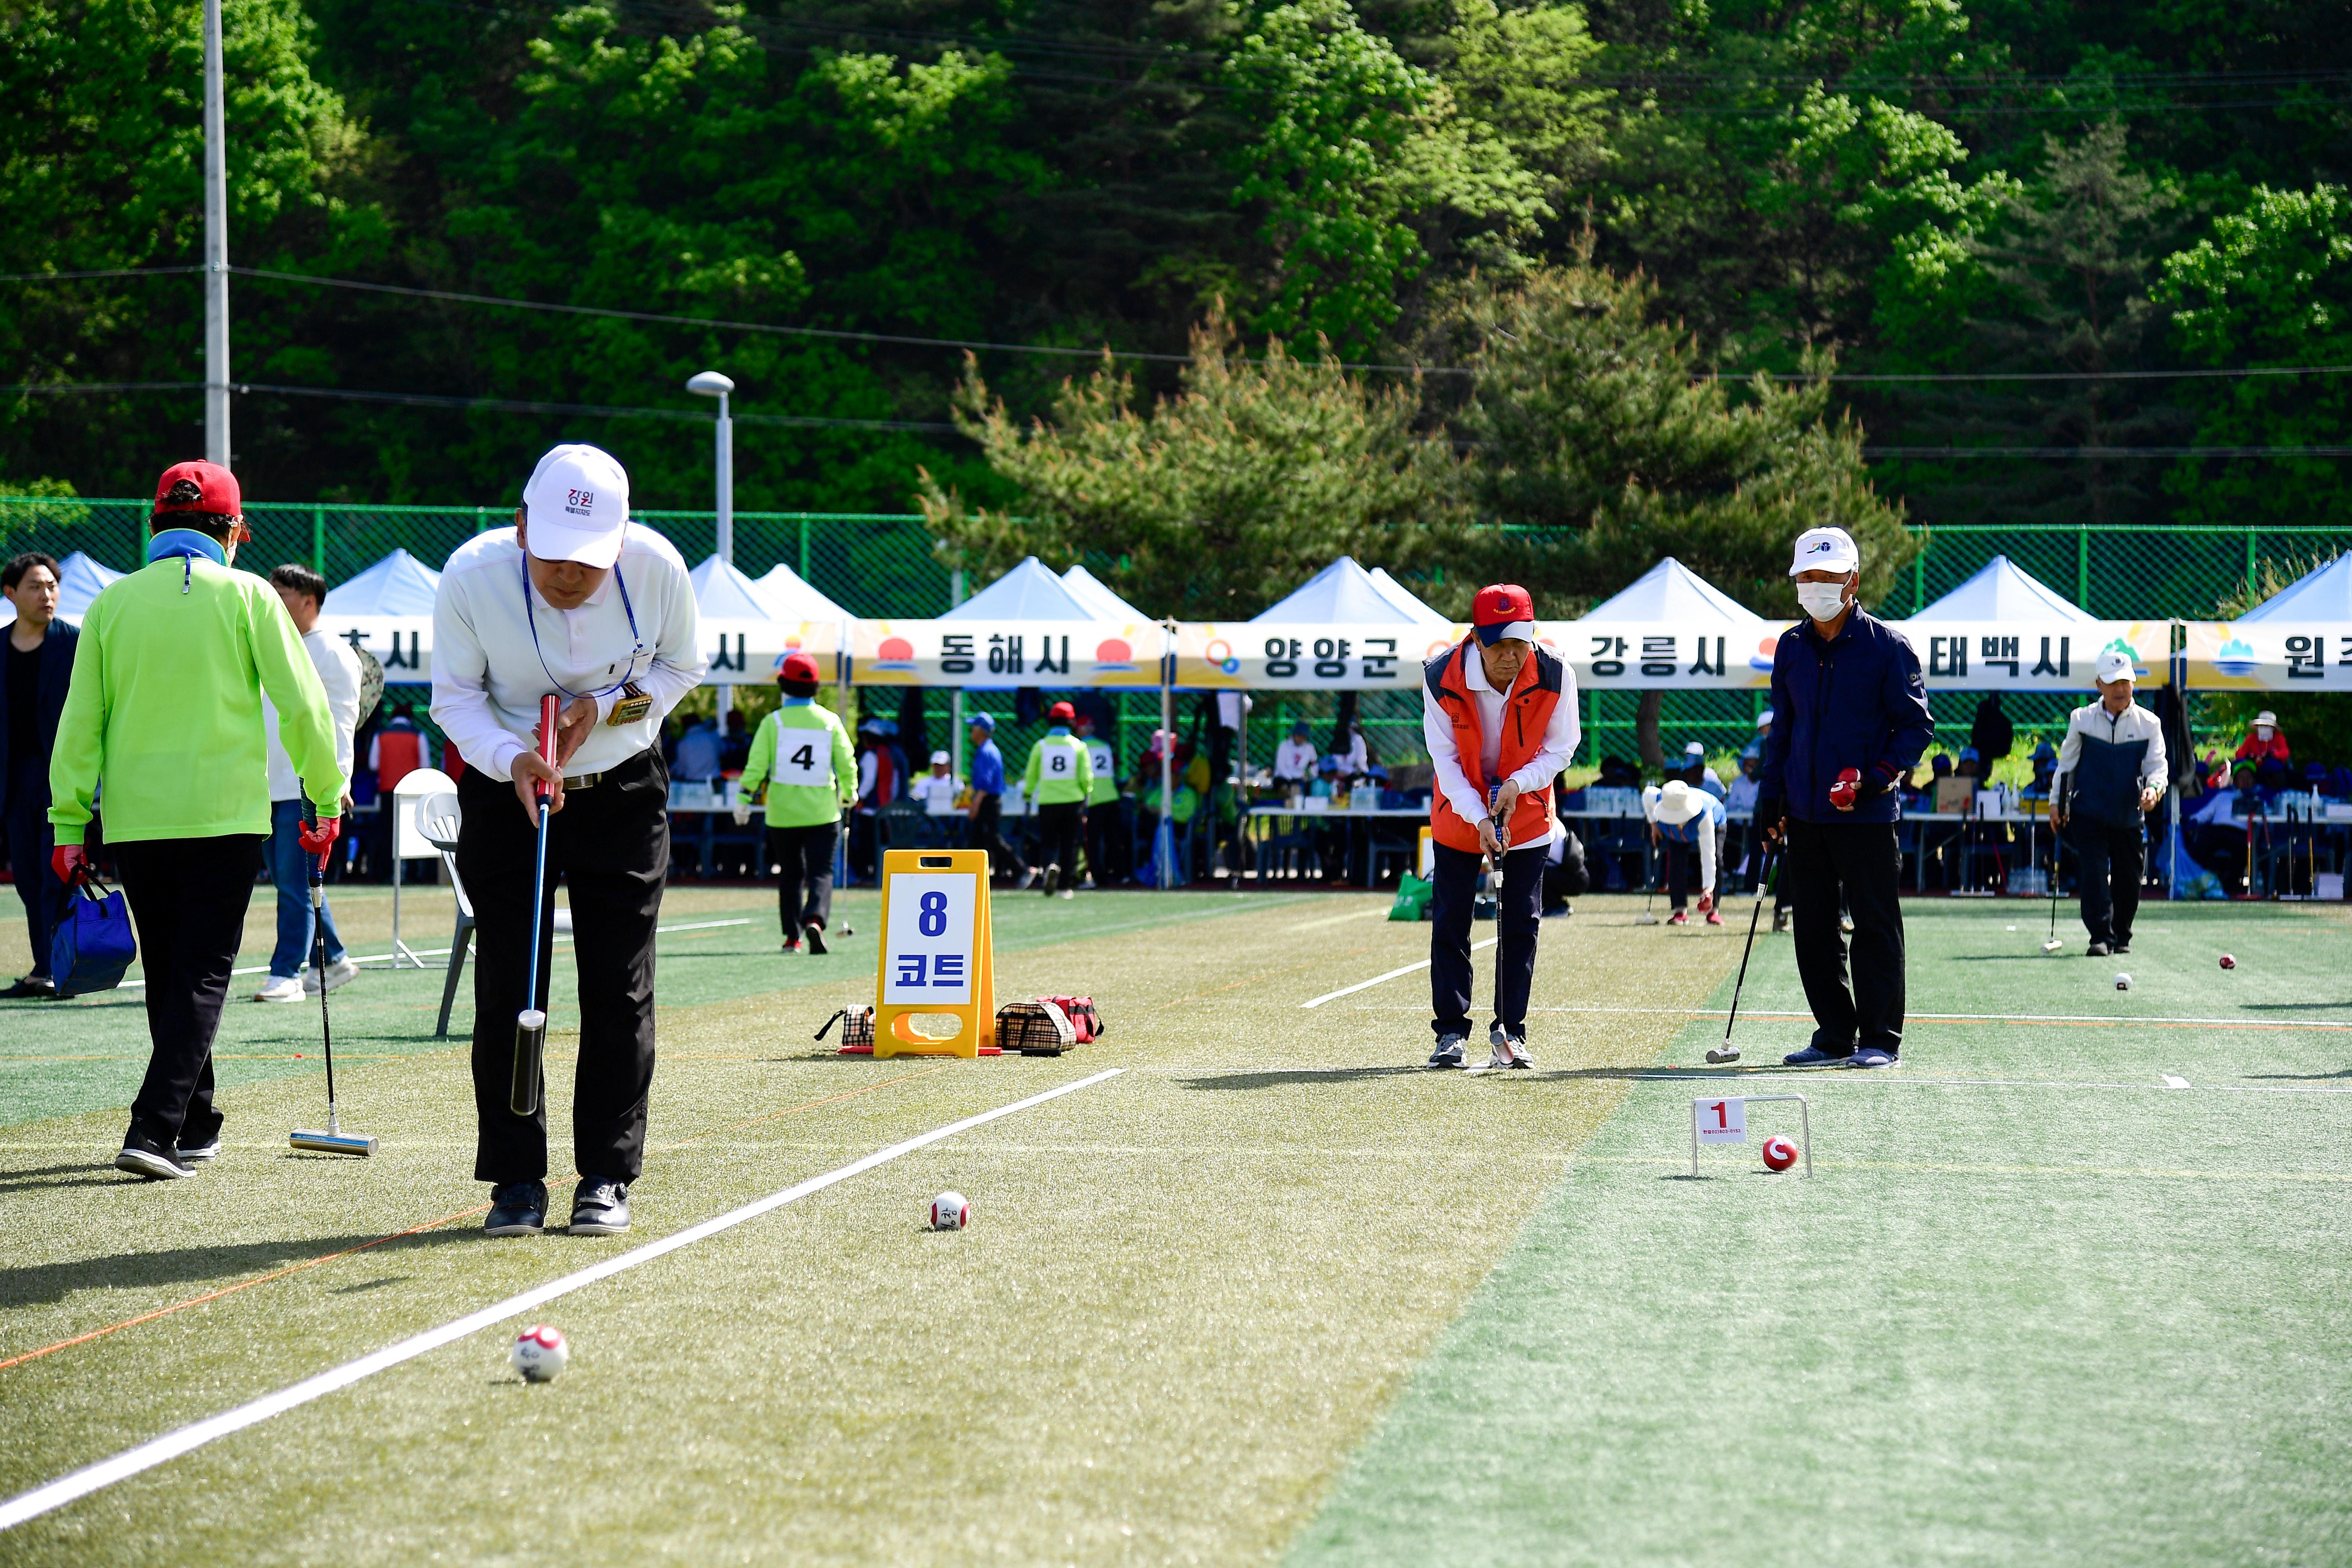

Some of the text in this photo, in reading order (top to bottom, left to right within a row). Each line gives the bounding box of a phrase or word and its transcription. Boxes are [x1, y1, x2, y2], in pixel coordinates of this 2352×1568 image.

[568, 489, 593, 508] 강원
[941, 634, 1068, 673] 동해시
[1265, 639, 1398, 677] 양양군
[1586, 637, 1725, 676] 강릉시
[1930, 637, 2070, 676] 태백시
[791, 745, 815, 770] 4
[1052, 756, 1065, 771] 8
[1095, 755, 1107, 770] 2
[919, 891, 947, 937] 8
[896, 954, 964, 987] 코트
[1711, 1102, 1727, 1128] 1
